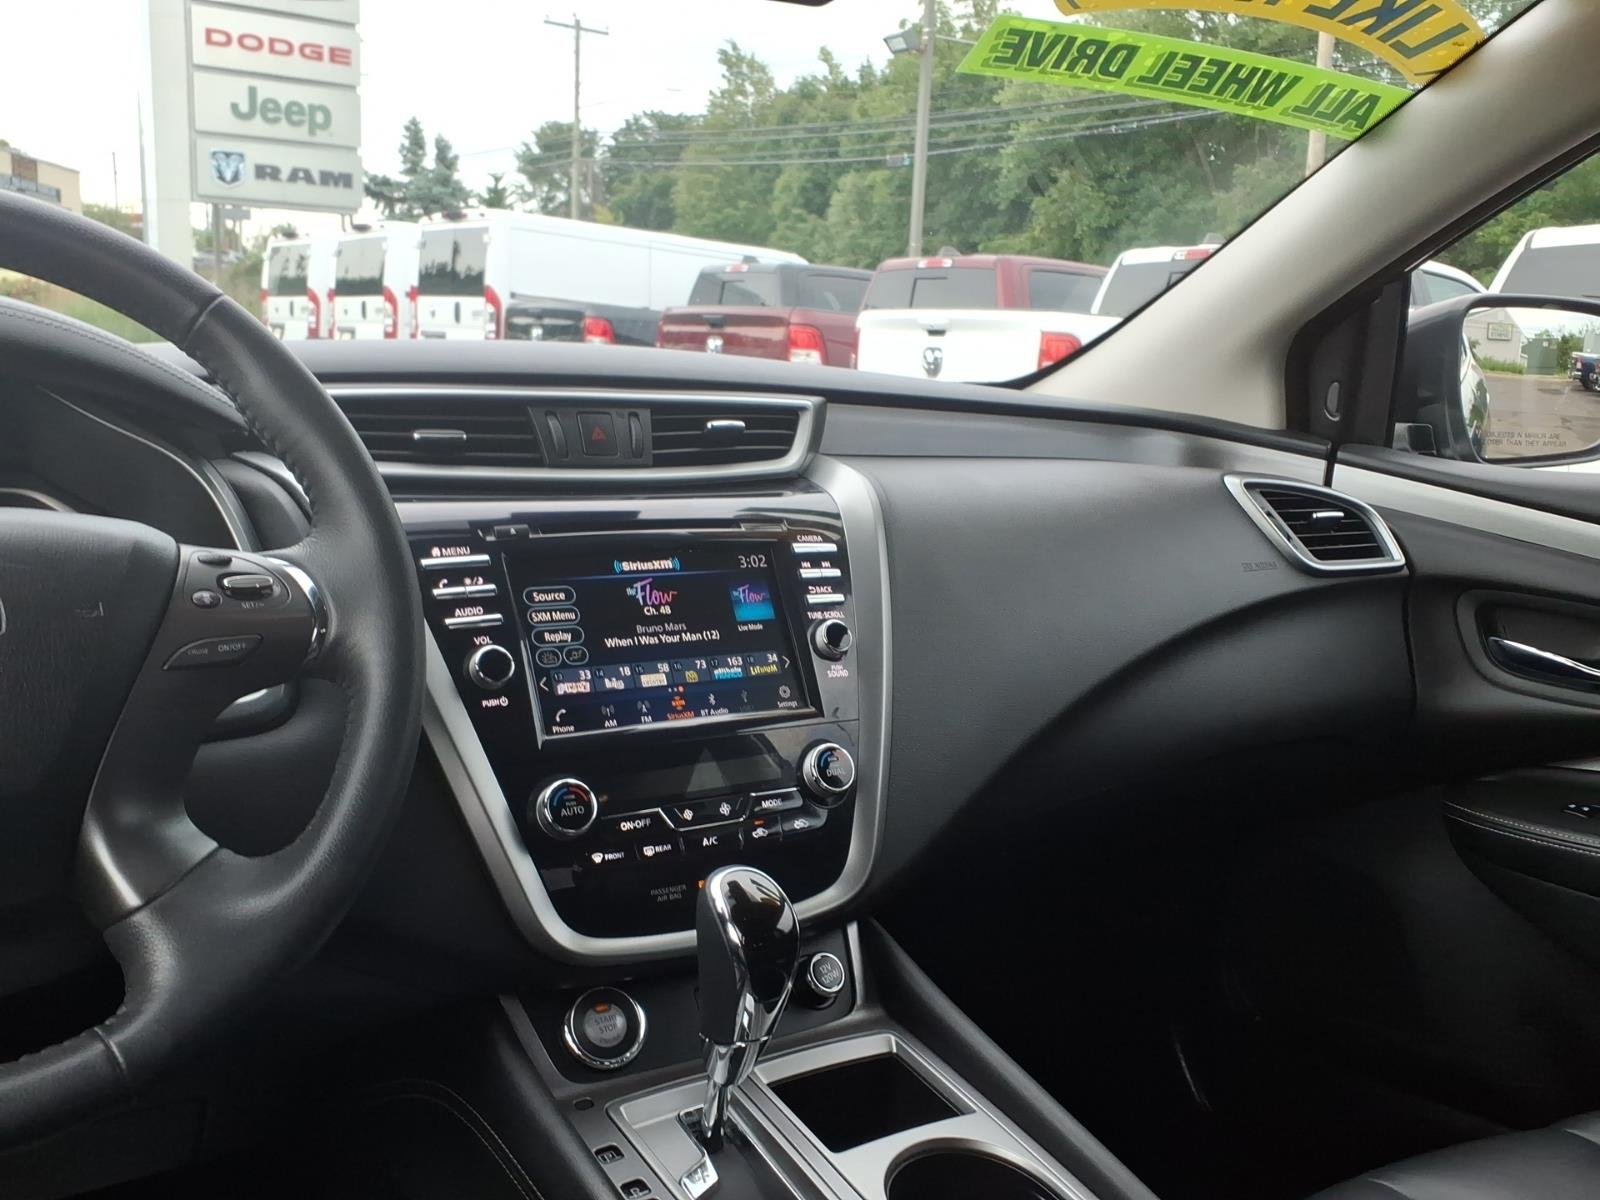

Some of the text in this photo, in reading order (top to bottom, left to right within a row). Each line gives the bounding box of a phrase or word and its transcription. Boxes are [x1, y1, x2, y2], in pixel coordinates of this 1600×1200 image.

[204, 27, 353, 67] DODGE
[230, 85, 332, 136] Jeep
[254, 163, 354, 189] RAM
[797, 534, 823, 542] CAMERA
[442, 546, 471, 556] MENU
[738, 554, 768, 568] 3:02
[532, 591, 566, 602] Source
[454, 606, 484, 617] AUDIO
[643, 605, 672, 616] Ch. 48
[531, 611, 576, 622] SXM Menu
[636, 622, 687, 634] Bruno Mars
[474, 636, 493, 645] VOL
[544, 631, 572, 643] Replay
[604, 637, 633, 649] When
[640, 634, 659, 646] Was
[660, 632, 681, 644] Your
[682, 631, 702, 642] Man
[703, 629, 721, 641] (12)
[727, 656, 743, 666] 163
[766, 653, 778, 663] 34
[657, 662, 670, 673] 58
[695, 659, 707, 670] 73
[578, 669, 592, 680] 33
[619, 666, 631, 677] 18
[826, 669, 849, 678] SOUND
[482, 699, 500, 708] PUSH
[700, 707, 729, 717] BT Audio
[604, 719, 618, 728] AM
[640, 715, 653, 724] FM
[552, 724, 575, 734] Phone
[761, 798, 783, 808] MODE
[560, 805, 585, 817] AUTO
[702, 836, 718, 846] A/C
[655, 843, 672, 852] REAR
[604, 852, 625, 861] FRONT
[650, 884, 687, 896] PASSENGER
[669, 892, 682, 900] BAG
[598, 1023, 618, 1034] STOP
